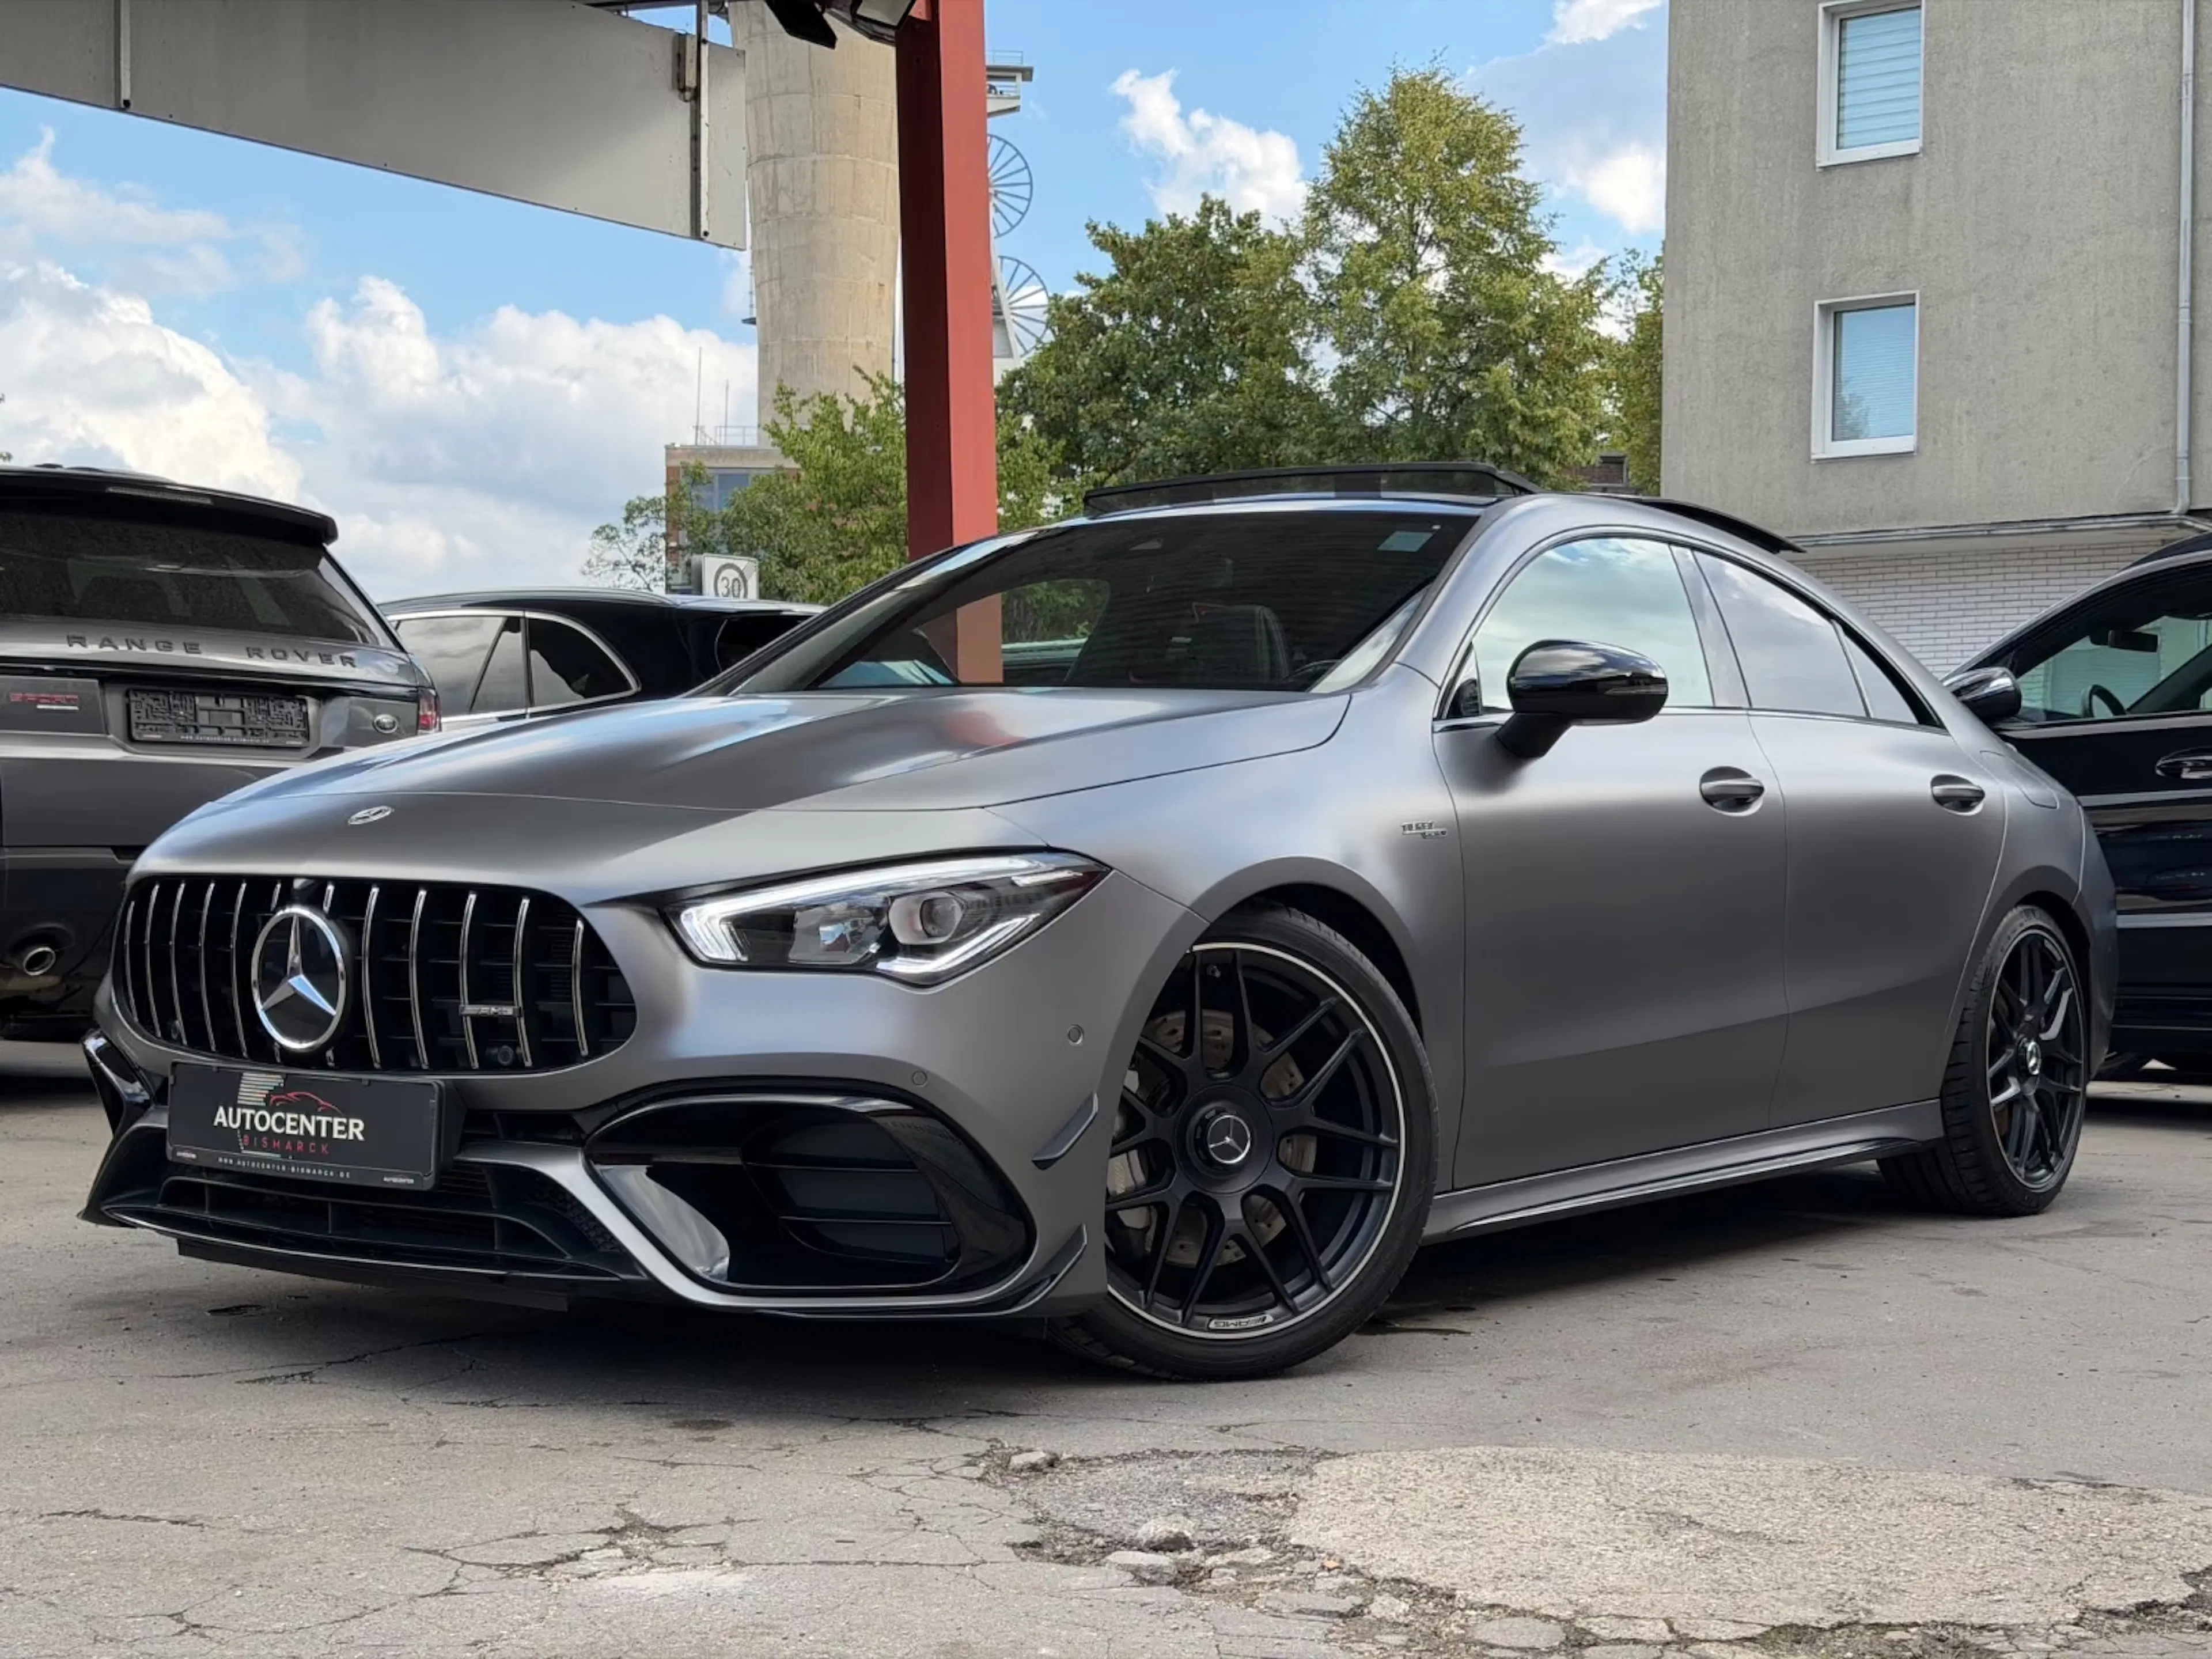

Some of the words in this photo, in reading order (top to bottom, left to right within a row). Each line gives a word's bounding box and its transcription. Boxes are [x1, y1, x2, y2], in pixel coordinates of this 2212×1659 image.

[721, 577, 741, 598] 30
[66, 634, 202, 654] RANGE
[246, 646, 357, 668] ROVER
[213, 1105, 365, 1141] AUTOCENTER
[243, 1135, 329, 1155] BISMARCK
